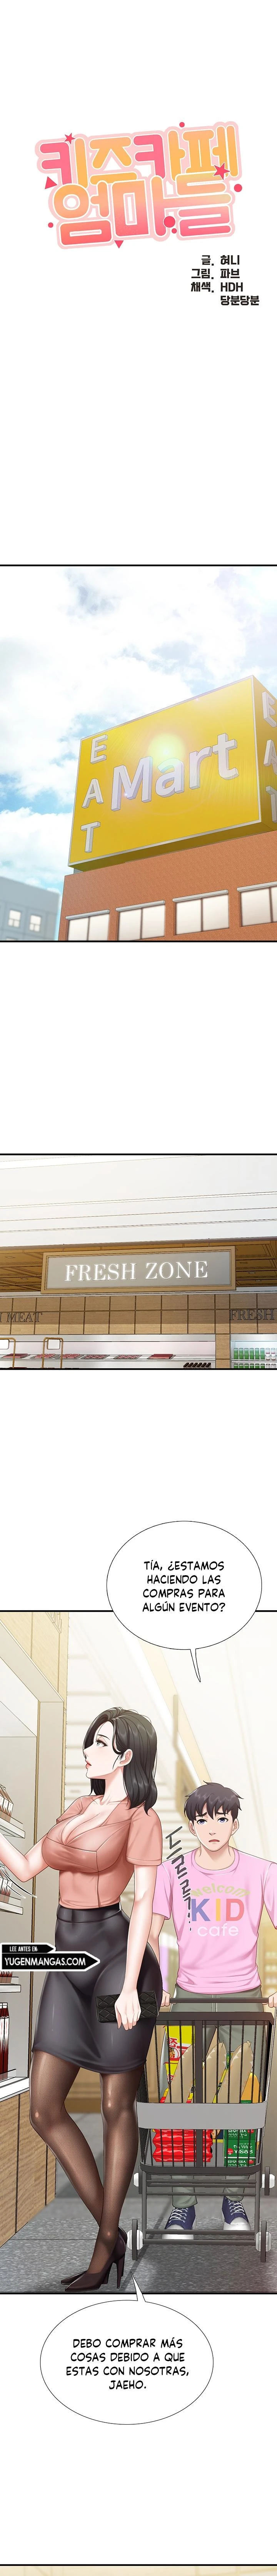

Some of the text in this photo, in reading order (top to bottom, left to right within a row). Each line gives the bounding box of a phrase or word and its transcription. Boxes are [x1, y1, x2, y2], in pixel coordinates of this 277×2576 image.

[40, 125, 239, 189] 키즈카페
[53, 172, 231, 245] 엄마들
[201, 255, 240, 266] 글. 혀니
[191, 268, 240, 279] 그림. 파브
[190, 282, 243, 293] 채색. HDH
[220, 295, 260, 305] 당분당분
[111, 733, 239, 811] Mart
[80, 734, 108, 853] EAT
[64, 1261, 208, 1282] FRESH ZONE
[6, 1312, 43, 1322] MEAT
[229, 1309, 275, 1320] FRESH
[144, 1559, 224, 1571] TÍA, ¿ESTAMOS
[147, 1574, 221, 1585] HACIENDO LAS
[143, 1588, 225, 1599] COMPRAS PARA
[142, 1601, 225, 1612] ALGÚN EVENTO?
[191, 1898, 244, 1921] KID
[197, 1923, 239, 1937] cafe
[73, 2337, 183, 2349] DEBO COMPRAR MÁS
[70, 2352, 185, 2362] COSAS DEBIDO A QUE
[66, 2366, 189, 2376] ESTAS CON NOSOTRAS,
[109, 2380, 146, 2390] JAEHO.
